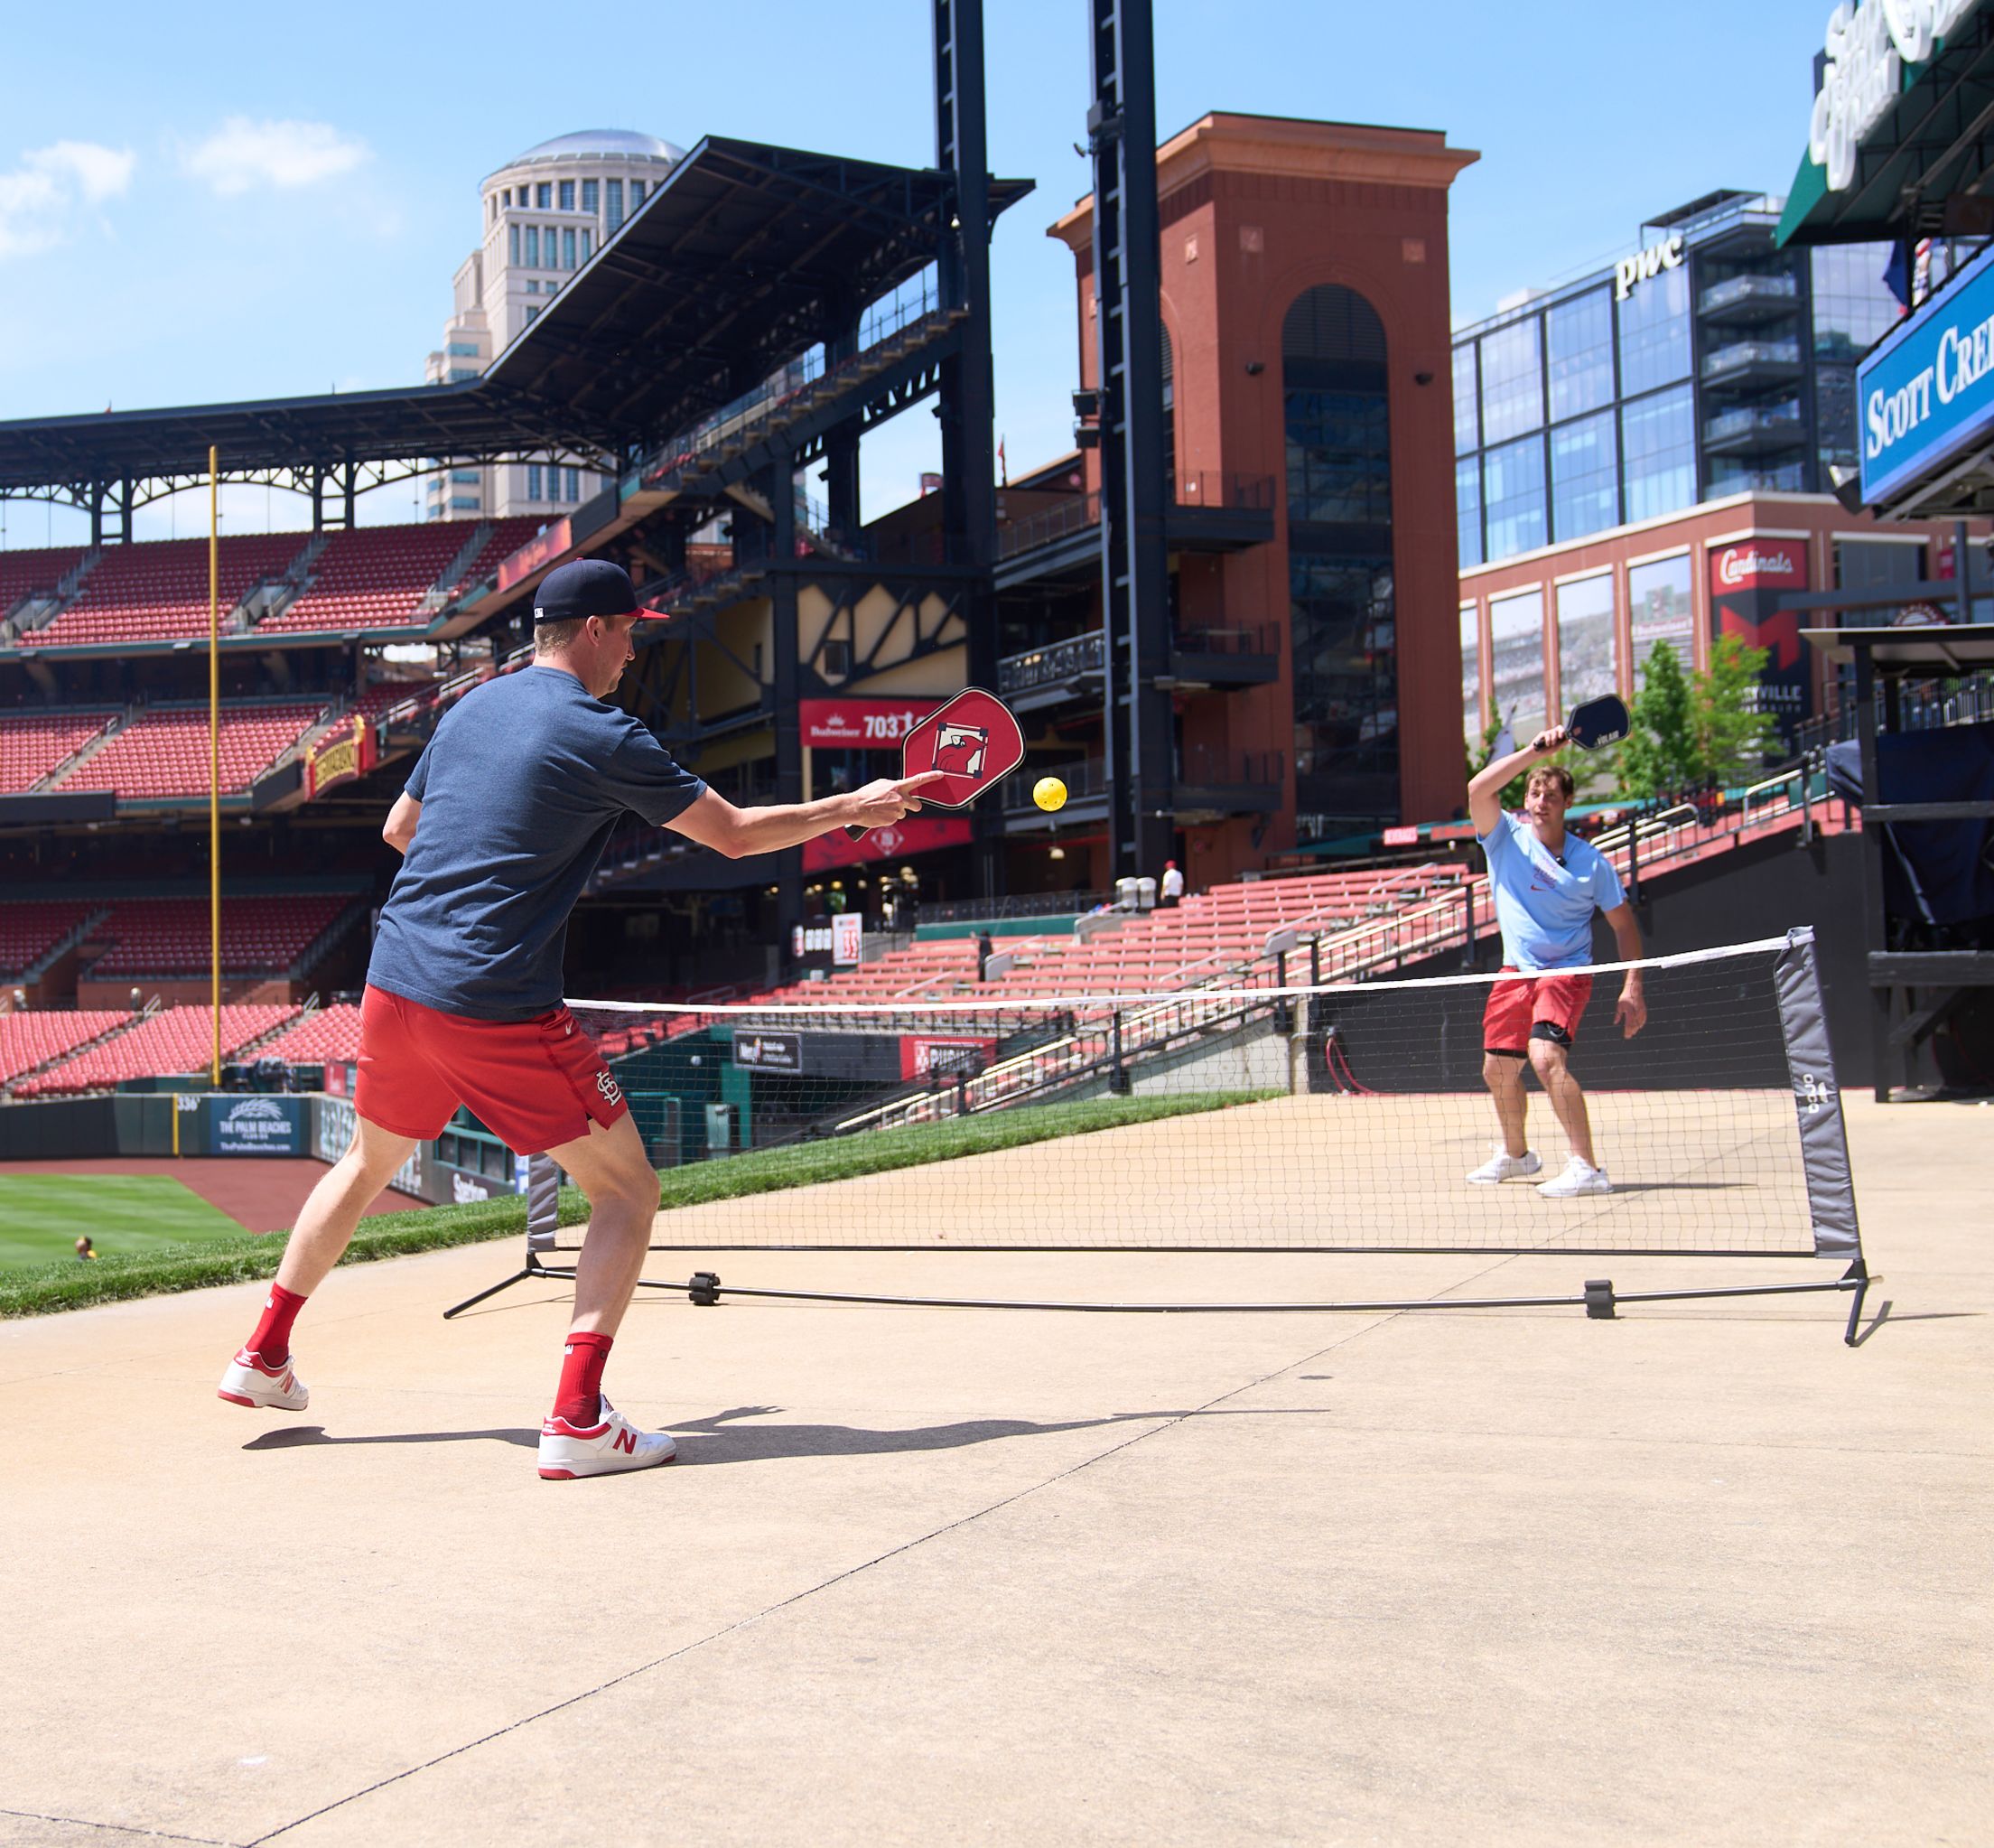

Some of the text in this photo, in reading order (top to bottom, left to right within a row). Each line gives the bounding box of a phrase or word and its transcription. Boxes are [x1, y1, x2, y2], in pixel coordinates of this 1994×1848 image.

[1615, 237, 1682, 302] pwc
[1719, 548, 1794, 584] Cardinals
[810, 725, 861, 738] Budweiser
[863, 715, 899, 738] 703
[219, 1121, 292, 1134] THE PALM BEACHES
[612, 1428, 638, 1455] N
